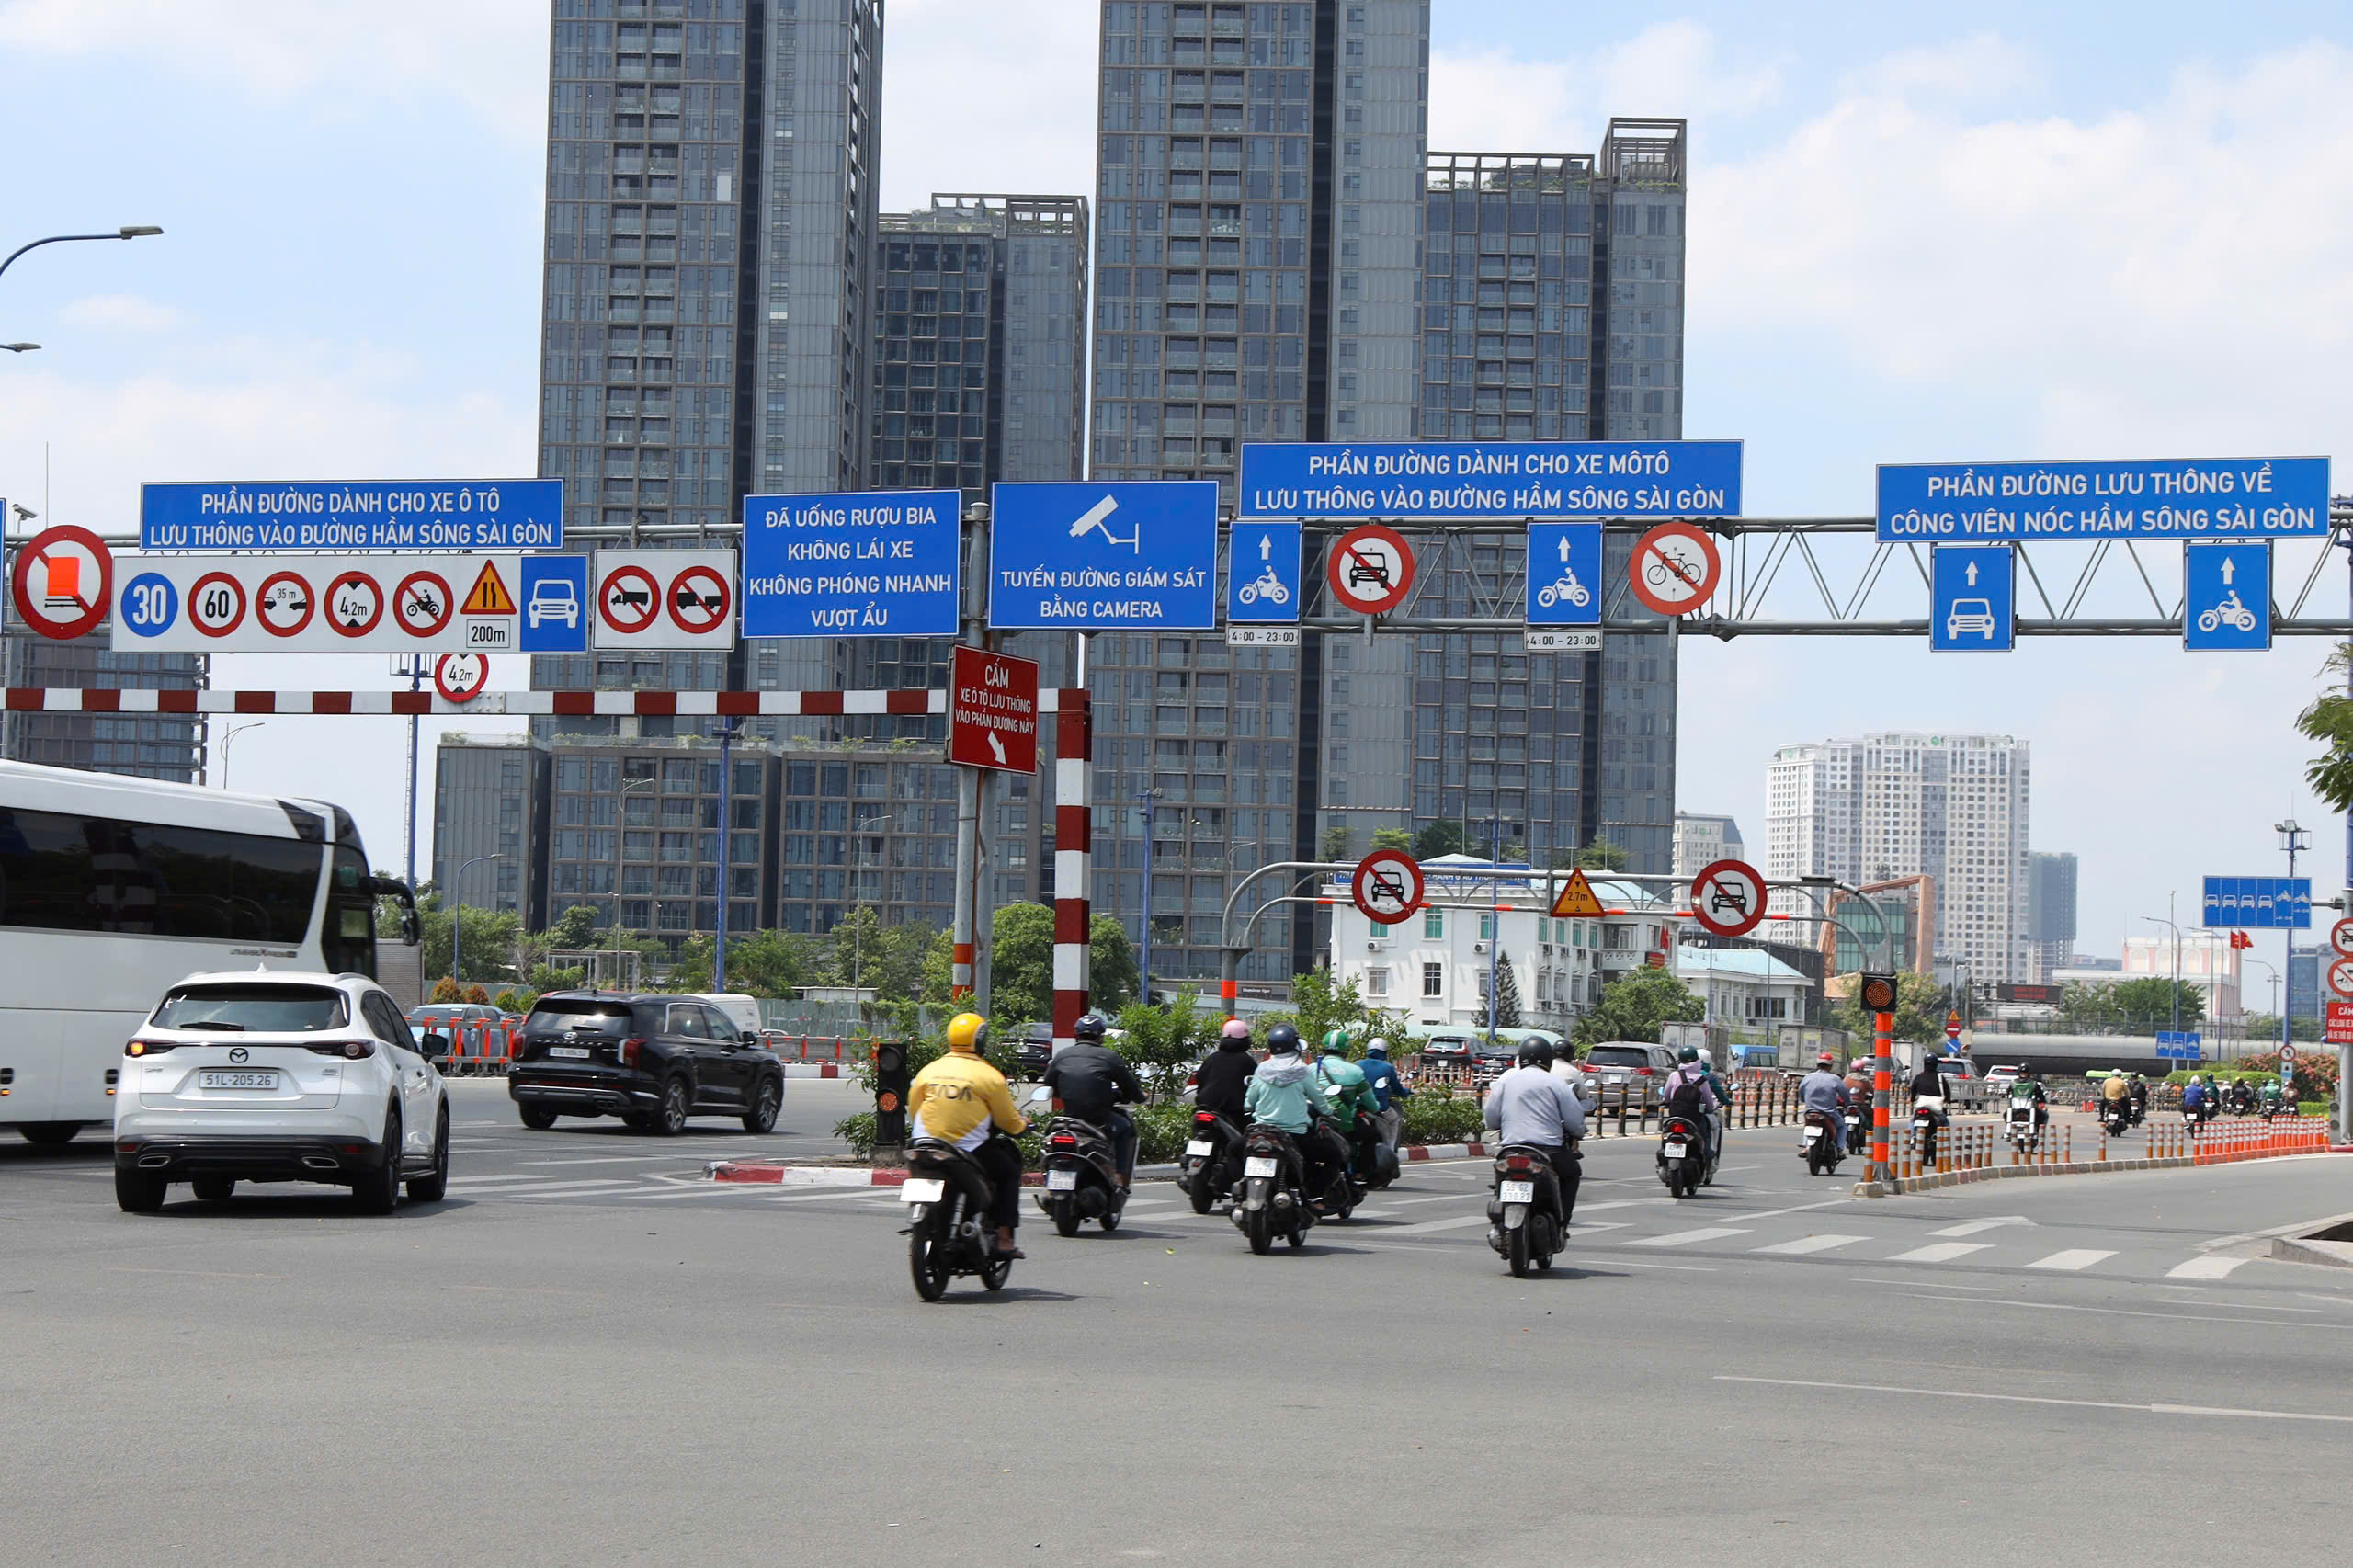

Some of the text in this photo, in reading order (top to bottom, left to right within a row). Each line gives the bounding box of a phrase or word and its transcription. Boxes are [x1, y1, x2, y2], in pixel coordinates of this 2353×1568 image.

[1309, 448, 1670, 475] PHẦN ĐƯỜNG DÀNH CHO XE MÔTÔ
[1927, 461, 2273, 498] PHẦN ĐƯỜNG LƯU THÔNG VỀ
[201, 485, 500, 515] PHẦN ĐƯỜNG DÀNH CHO XE Ô TÔ
[1255, 480, 1724, 510] LƯU THÔNG VÀO ĐƯỜNG HẦM SÔNG SÀI GÒN
[765, 503, 937, 529] ĐÃ UỐNG RƯỢU BIA
[1891, 501, 2315, 535] CÔNG VIÊN NÓC HẦM SÔNG SÀI GÒN
[150, 515, 552, 546] LƯU THÔNG VÀO ĐƯỜNG HẦM SÔNG SÀI GÒN
[788, 536, 914, 561] KHÔNG LÁI XE
[749, 571, 951, 596] KHÔNG PHÓNG NHANH
[1000, 563, 1207, 588] TUYẾN ĐƯỜNG GIÁM SÁT
[132, 584, 167, 625] 30
[204, 589, 230, 619] 60
[339, 596, 368, 616] 4.2m
[811, 600, 888, 631] VƯỢT ẨU
[1040, 593, 1163, 618] BẰNG CAMERA
[471, 625, 506, 642] 200m
[1232, 631, 1255, 642] 4:00
[1266, 631, 1295, 642] 23:00
[1530, 635, 1554, 646] 4:00
[1566, 635, 1597, 646] 23:00
[448, 664, 473, 682] 4.2m
[985, 658, 1008, 688] CẤM
[961, 687, 1030, 713] XE Ô TÔ LƯU THÔNG
[956, 706, 970, 723] VÀO
[1019, 718, 1034, 734] NÀY
[206, 1074, 272, 1086] 51L-205.26
